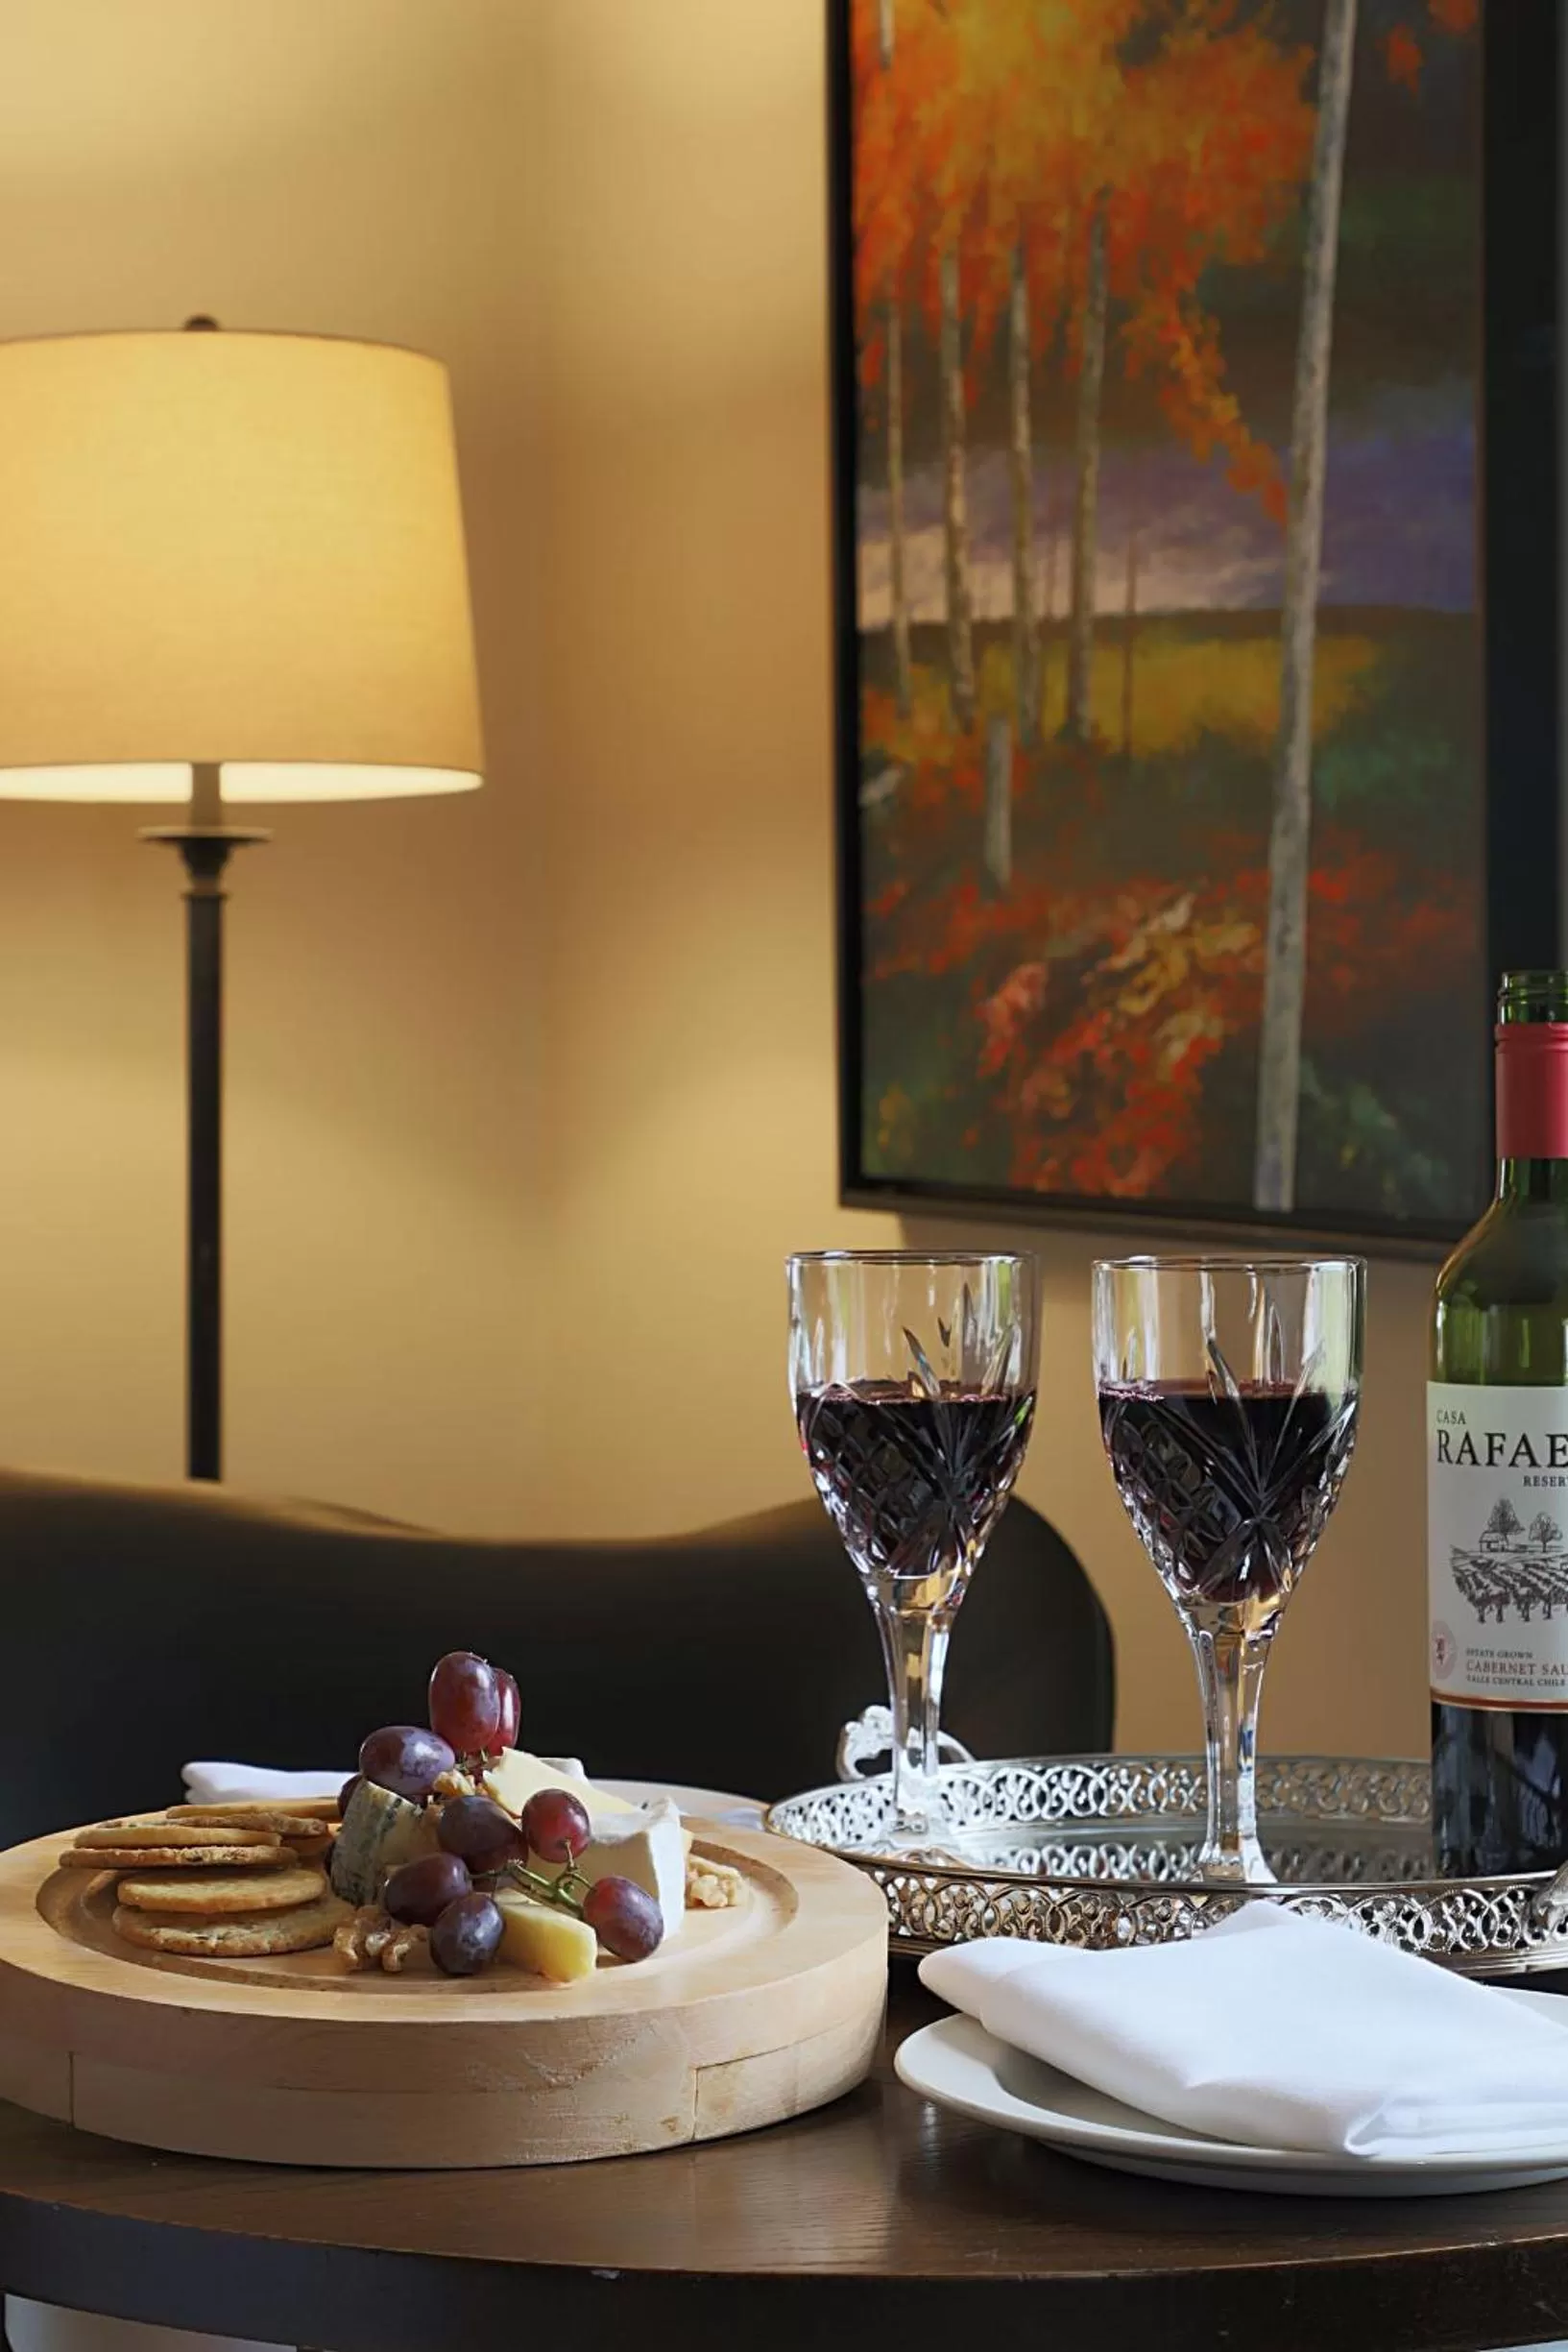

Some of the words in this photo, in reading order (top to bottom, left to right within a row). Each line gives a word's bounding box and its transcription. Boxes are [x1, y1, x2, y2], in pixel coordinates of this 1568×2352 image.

[1435, 1408, 1467, 1425] CASA
[1435, 1428, 1568, 1468] RAFAE
[1522, 1474, 1568, 1488] RESER
[1465, 1660, 1537, 1676] CABERNET
[1492, 1677, 1535, 1686] CENTRAL
